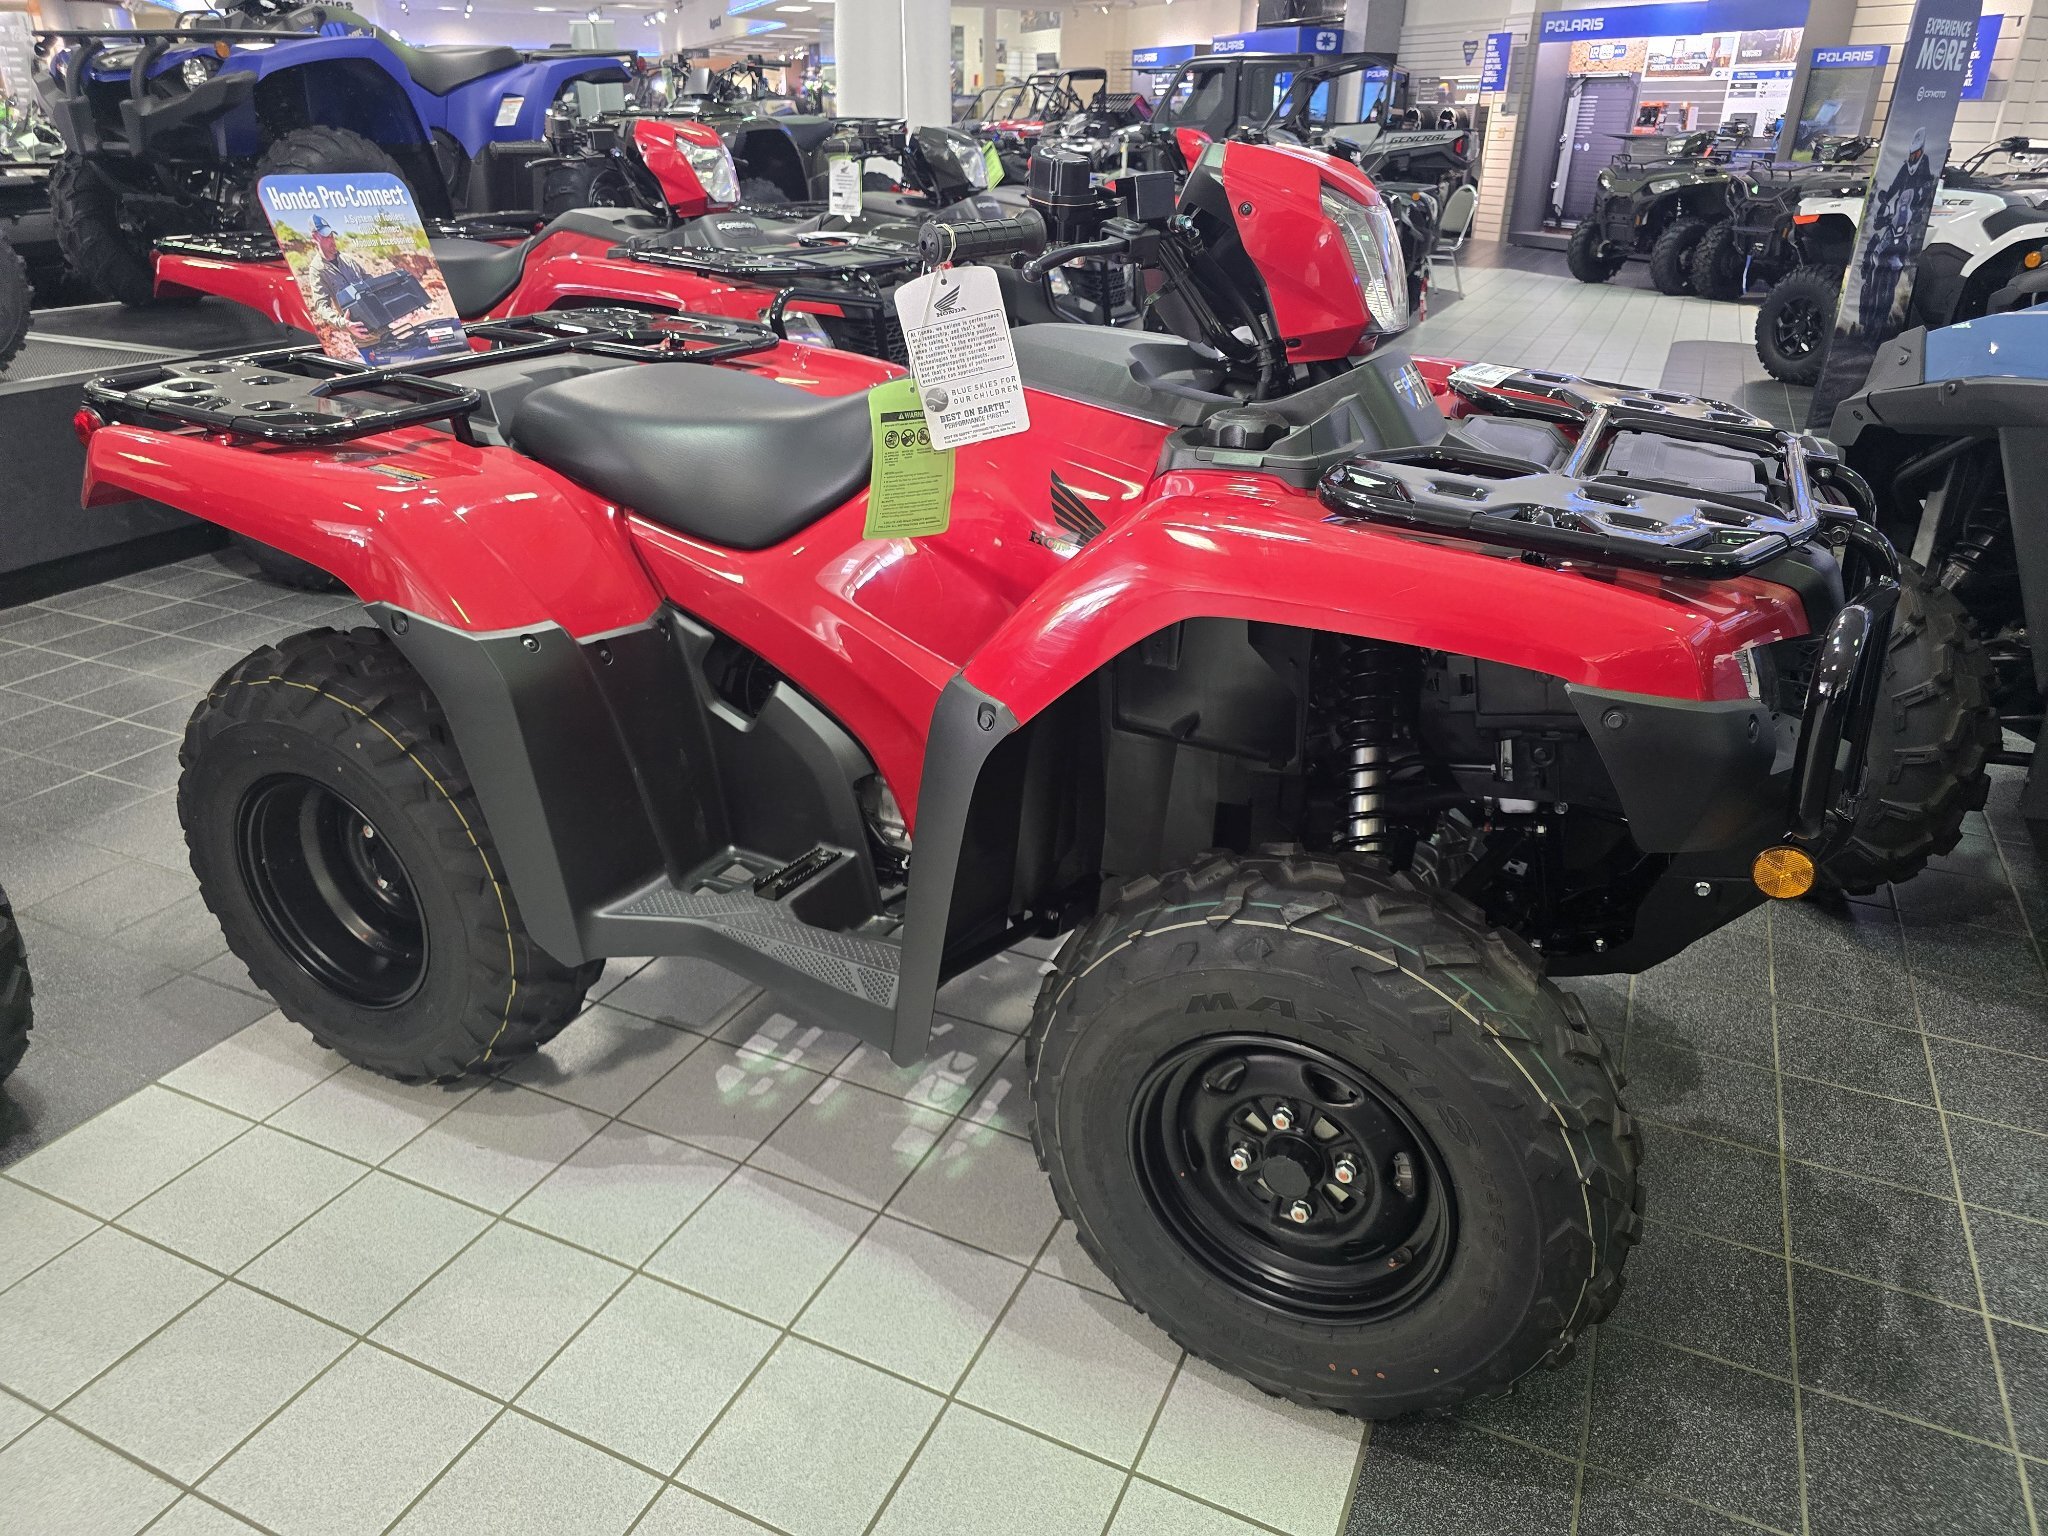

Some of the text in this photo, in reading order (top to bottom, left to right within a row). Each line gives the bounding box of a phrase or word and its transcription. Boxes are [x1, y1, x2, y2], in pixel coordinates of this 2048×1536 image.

[1545, 18, 1604, 33] POLARIS
[1925, 18, 1971, 37] EXPERIENCE
[1213, 40, 1245, 52] POLARIS
[1134, 53, 1157, 62] POLARIS
[1817, 51, 1874, 62] POLARIS
[1915, 38, 1967, 71] MORE
[1366, 70, 1389, 78] POLAR
[1390, 134, 1447, 143] GENERAL
[266, 184, 408, 210] Honda Pro-Connect
[936, 306, 966, 317] HONDA
[951, 375, 1016, 395] BLUE SKIES FOR
[953, 384, 1018, 405] OUR CHILDREN
[939, 411, 962, 423] BEST
[963, 408, 975, 417] ON
[944, 414, 986, 429] PERFORMANCE
[1185, 991, 1480, 1148] MAXXIS
